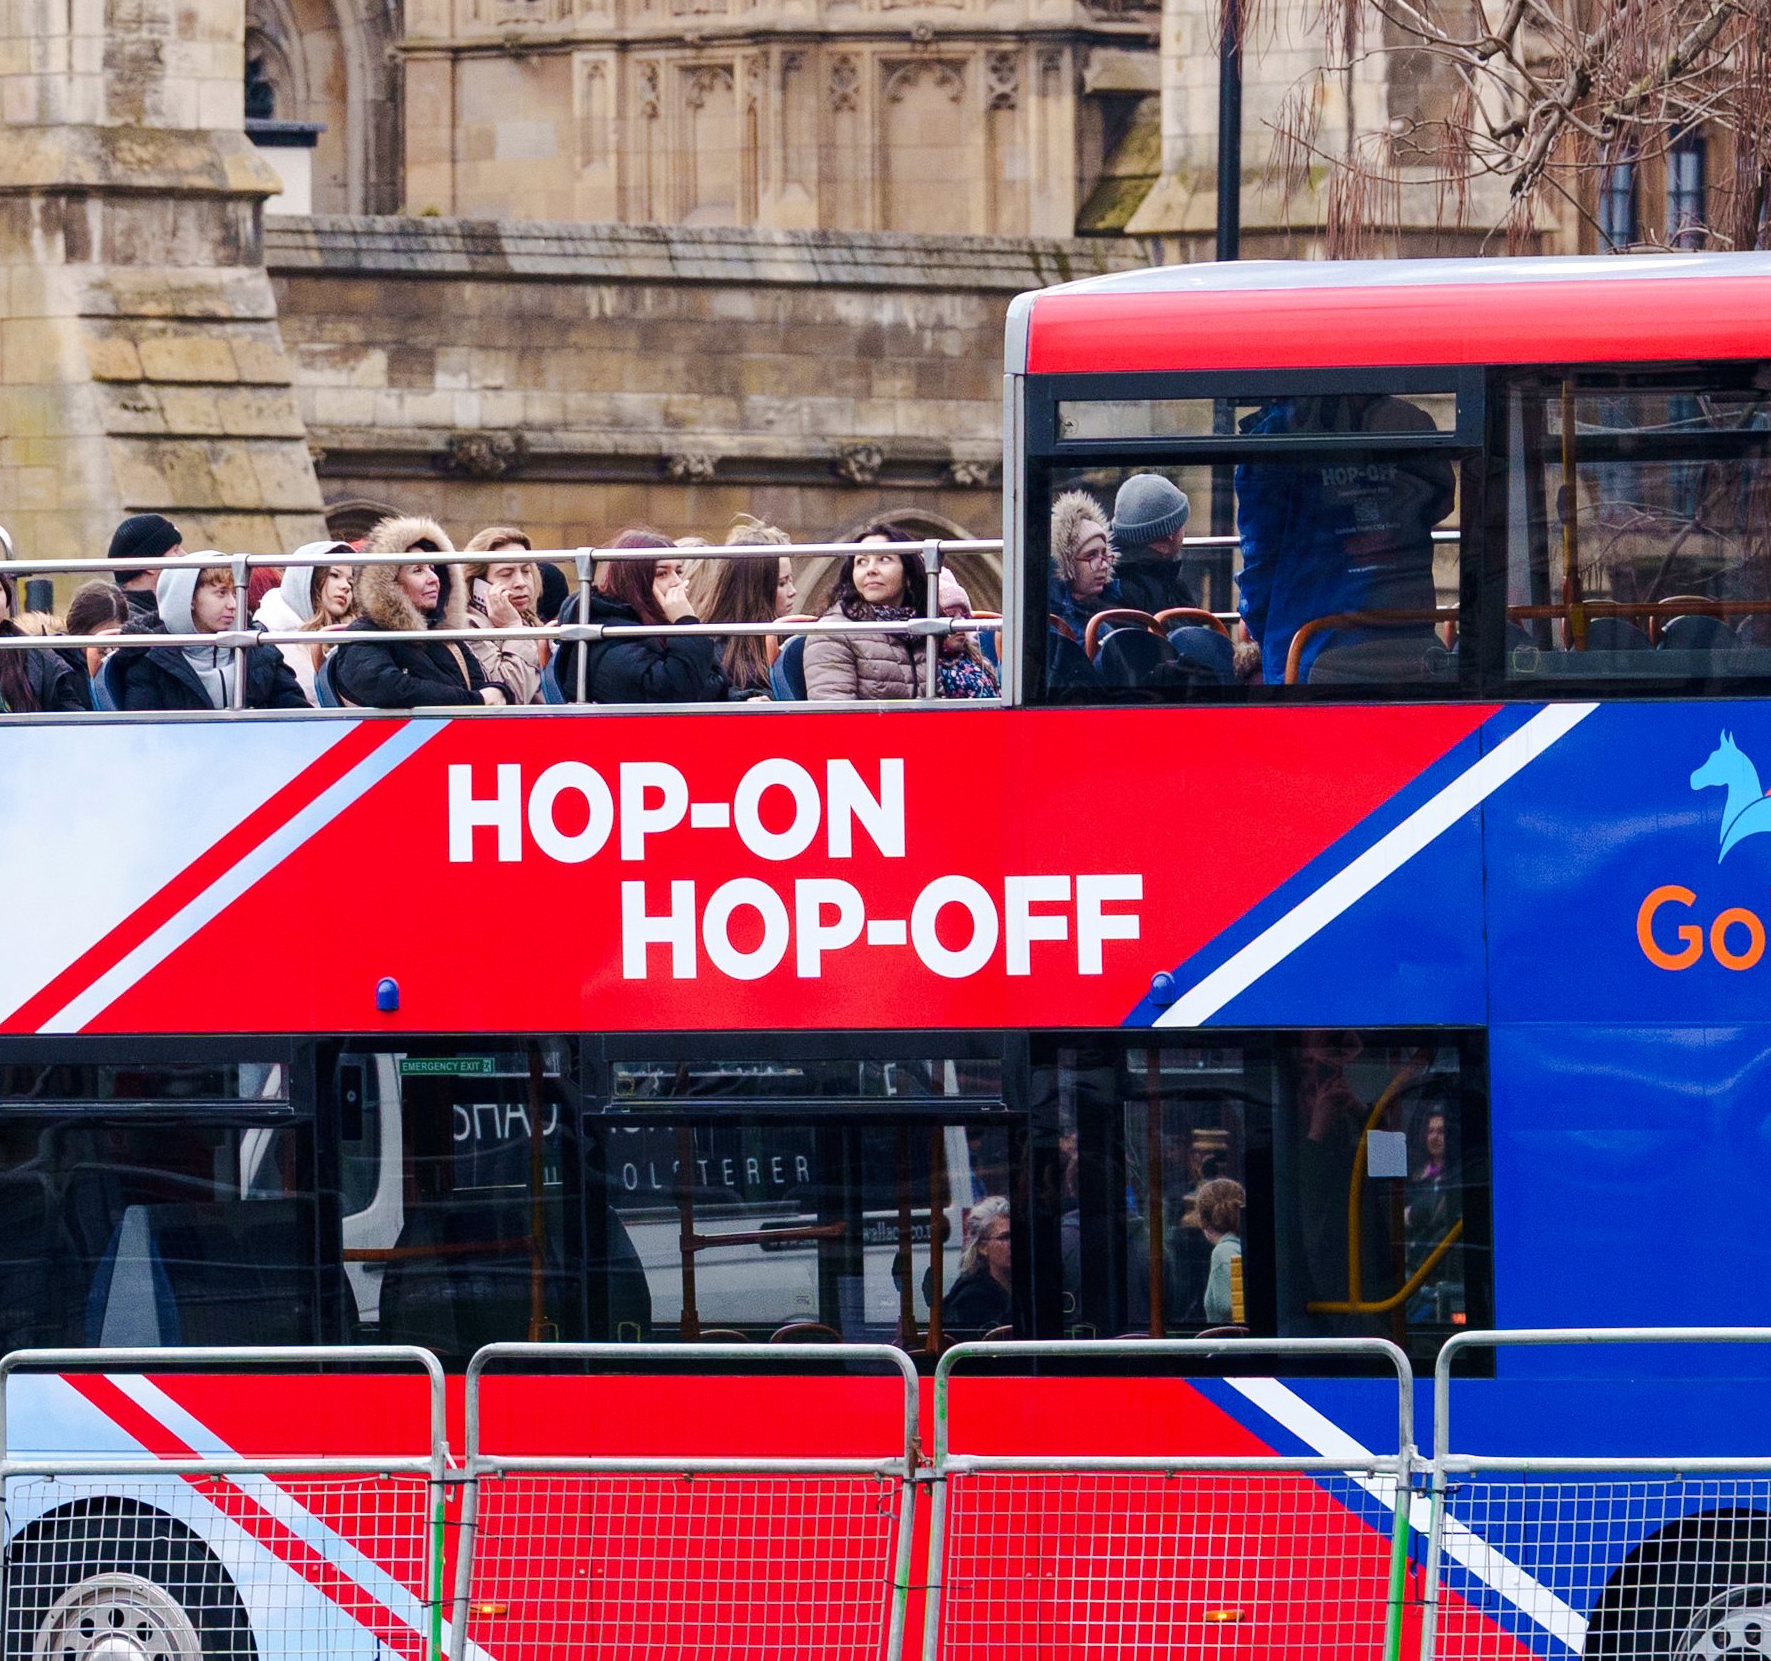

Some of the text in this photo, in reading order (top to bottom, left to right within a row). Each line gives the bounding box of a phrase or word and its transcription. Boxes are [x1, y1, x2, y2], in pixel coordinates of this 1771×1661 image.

[448, 756, 906, 864] HOP-ON
[621, 874, 1144, 981] HOP-OFF
[402, 1061, 480, 1072] EMERGENCY EXIT
[623, 1155, 810, 1191] OLTERER
